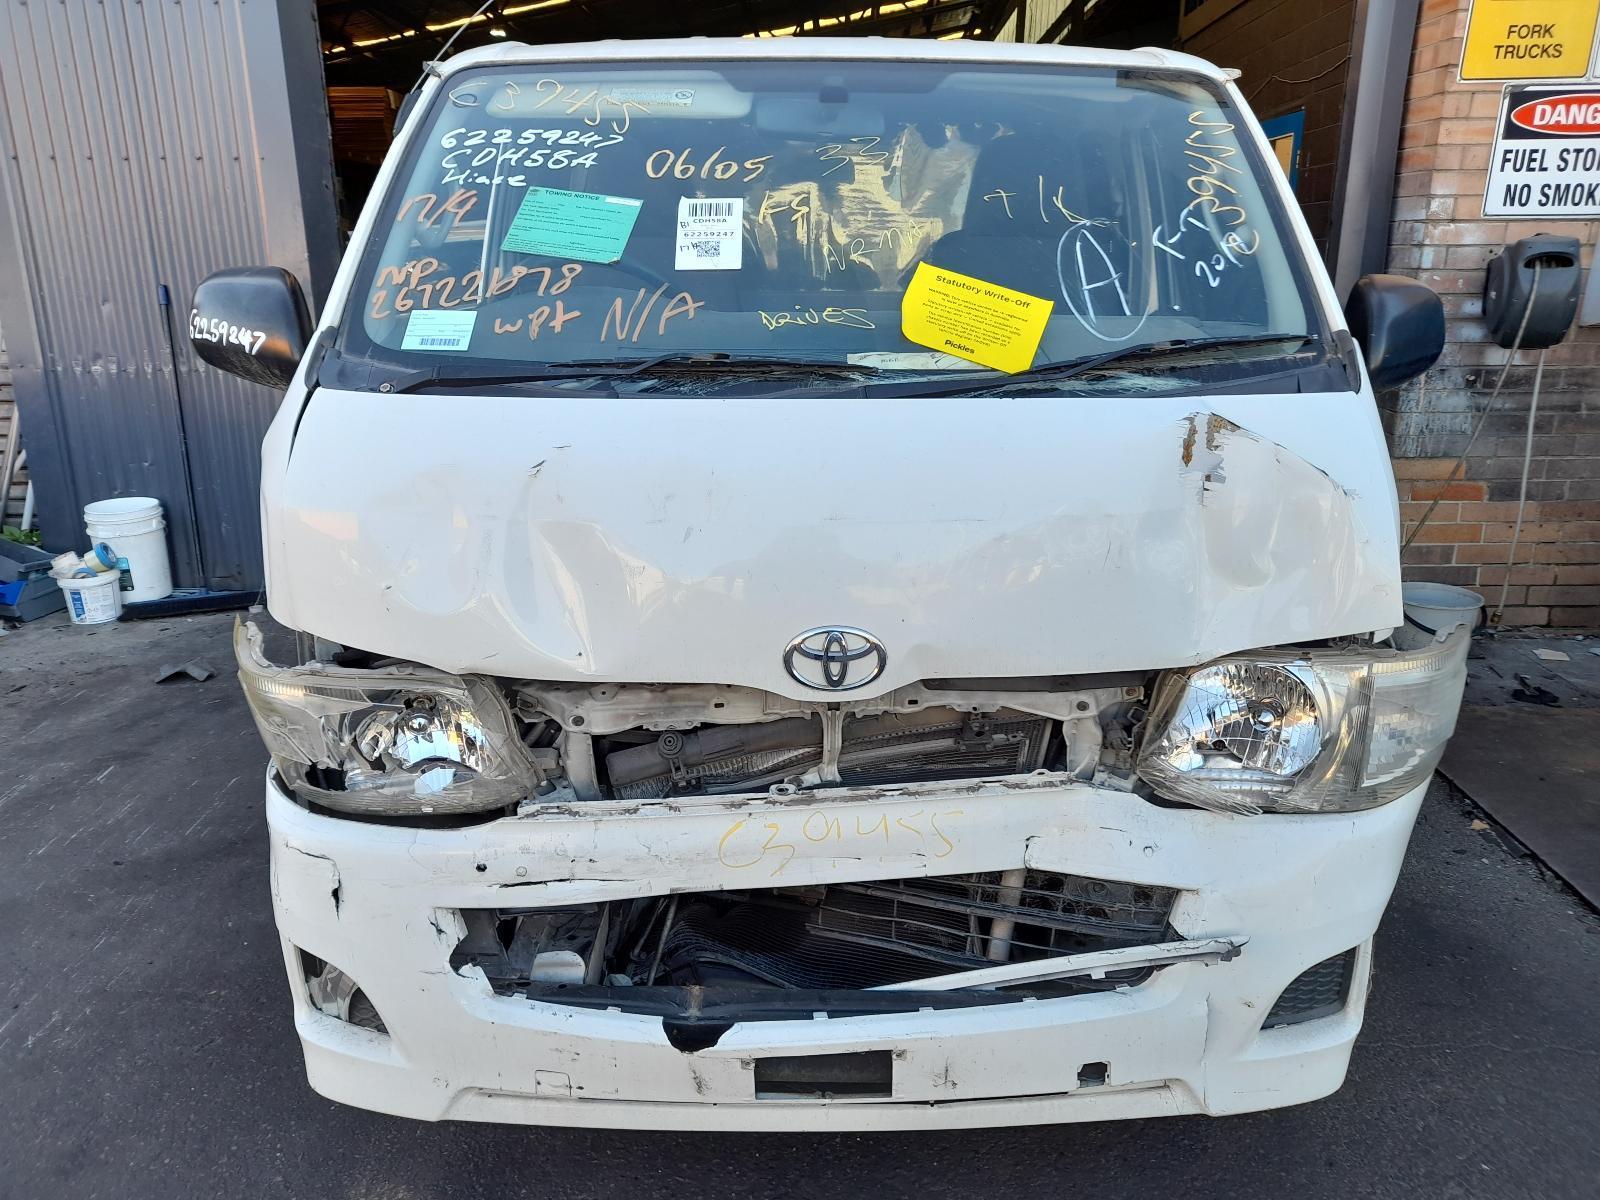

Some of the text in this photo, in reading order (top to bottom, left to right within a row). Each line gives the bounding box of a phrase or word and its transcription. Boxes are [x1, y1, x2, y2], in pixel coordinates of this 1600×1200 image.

[1506, 24, 1556, 39] FORK
[1494, 44, 1563, 59] TRUCKS
[441, 147, 599, 169] CDH58A
[1500, 148, 1600, 172] FUEL STO
[545, 189, 600, 201] TOWING NOTICE
[1503, 183, 1600, 207] NO SMOK
[935, 275, 981, 295] Statutory
[984, 289, 1032, 309] Write-Off
[944, 339, 975, 354] Pickles
